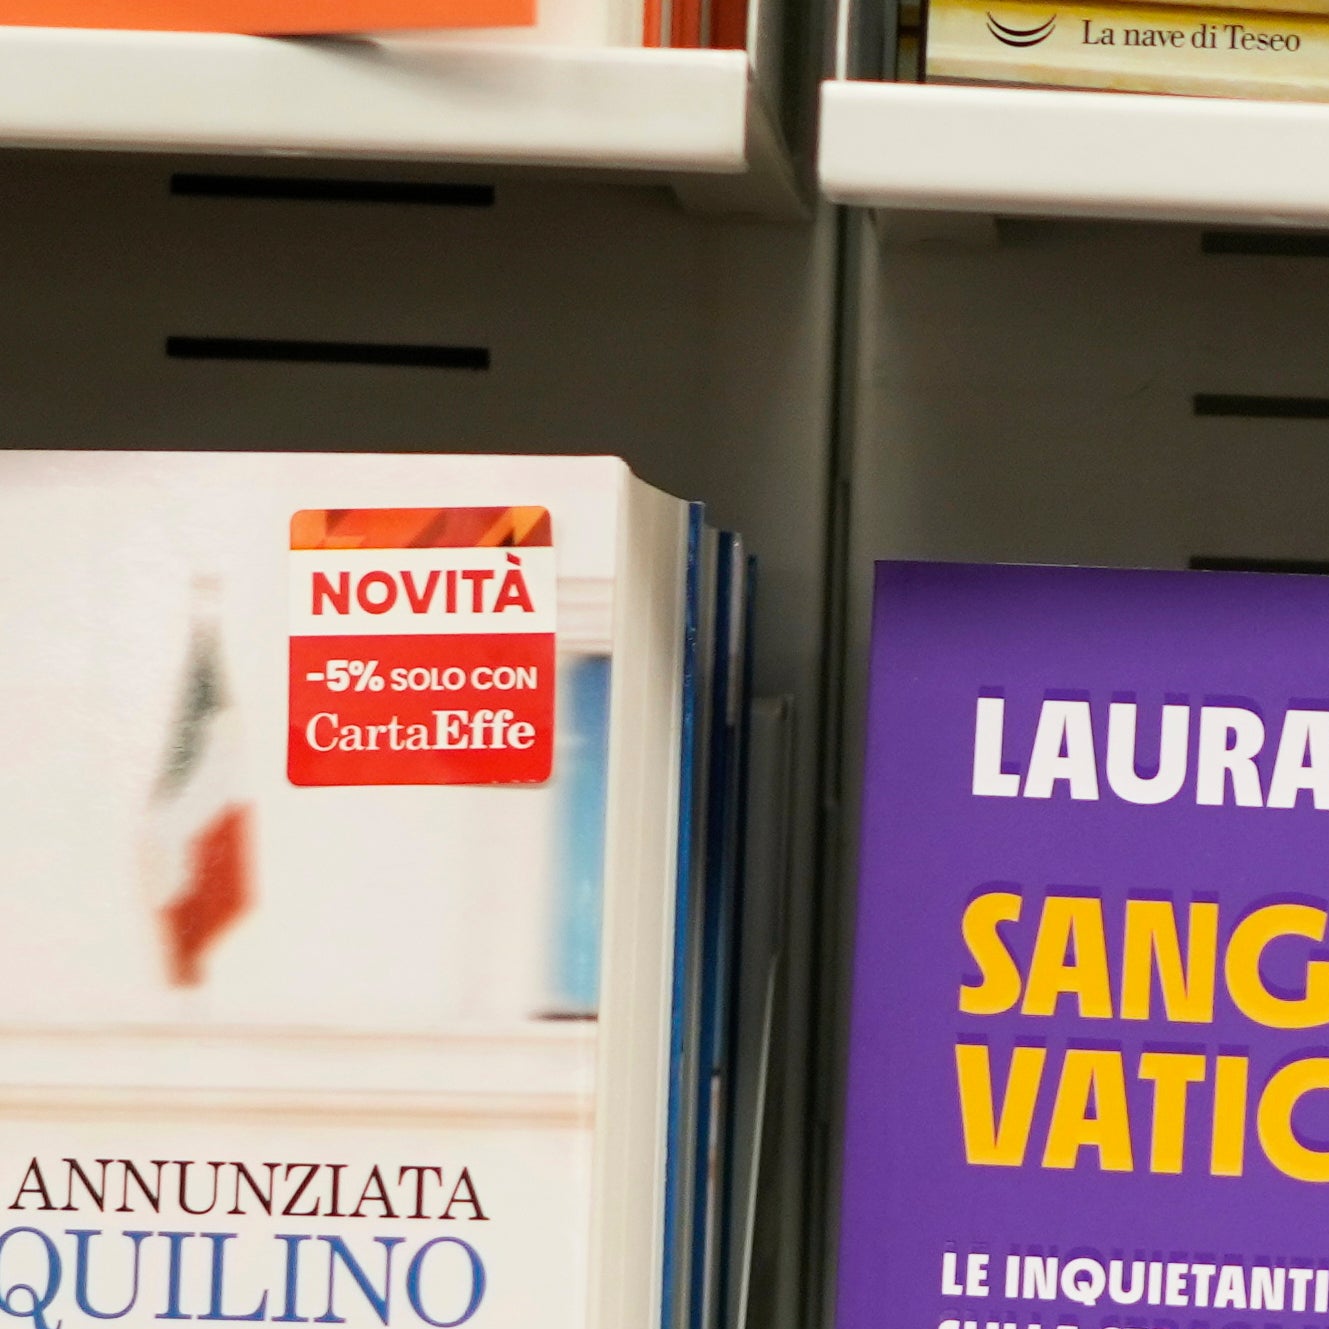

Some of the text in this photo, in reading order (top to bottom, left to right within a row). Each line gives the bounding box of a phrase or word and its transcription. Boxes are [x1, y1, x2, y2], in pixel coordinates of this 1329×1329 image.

[1081, 19, 1301, 51] La nave di Teseo
[311, 552, 535, 616] NOVITÀ
[305, 659, 538, 693] -5% SOLO CON
[305, 709, 537, 752] CartaEffe
[7, 1156, 491, 1221] ANNUNZIATA
[940, 1251, 991, 1298] LE
[1004, 1256, 1329, 1314] INQUIETANTI
